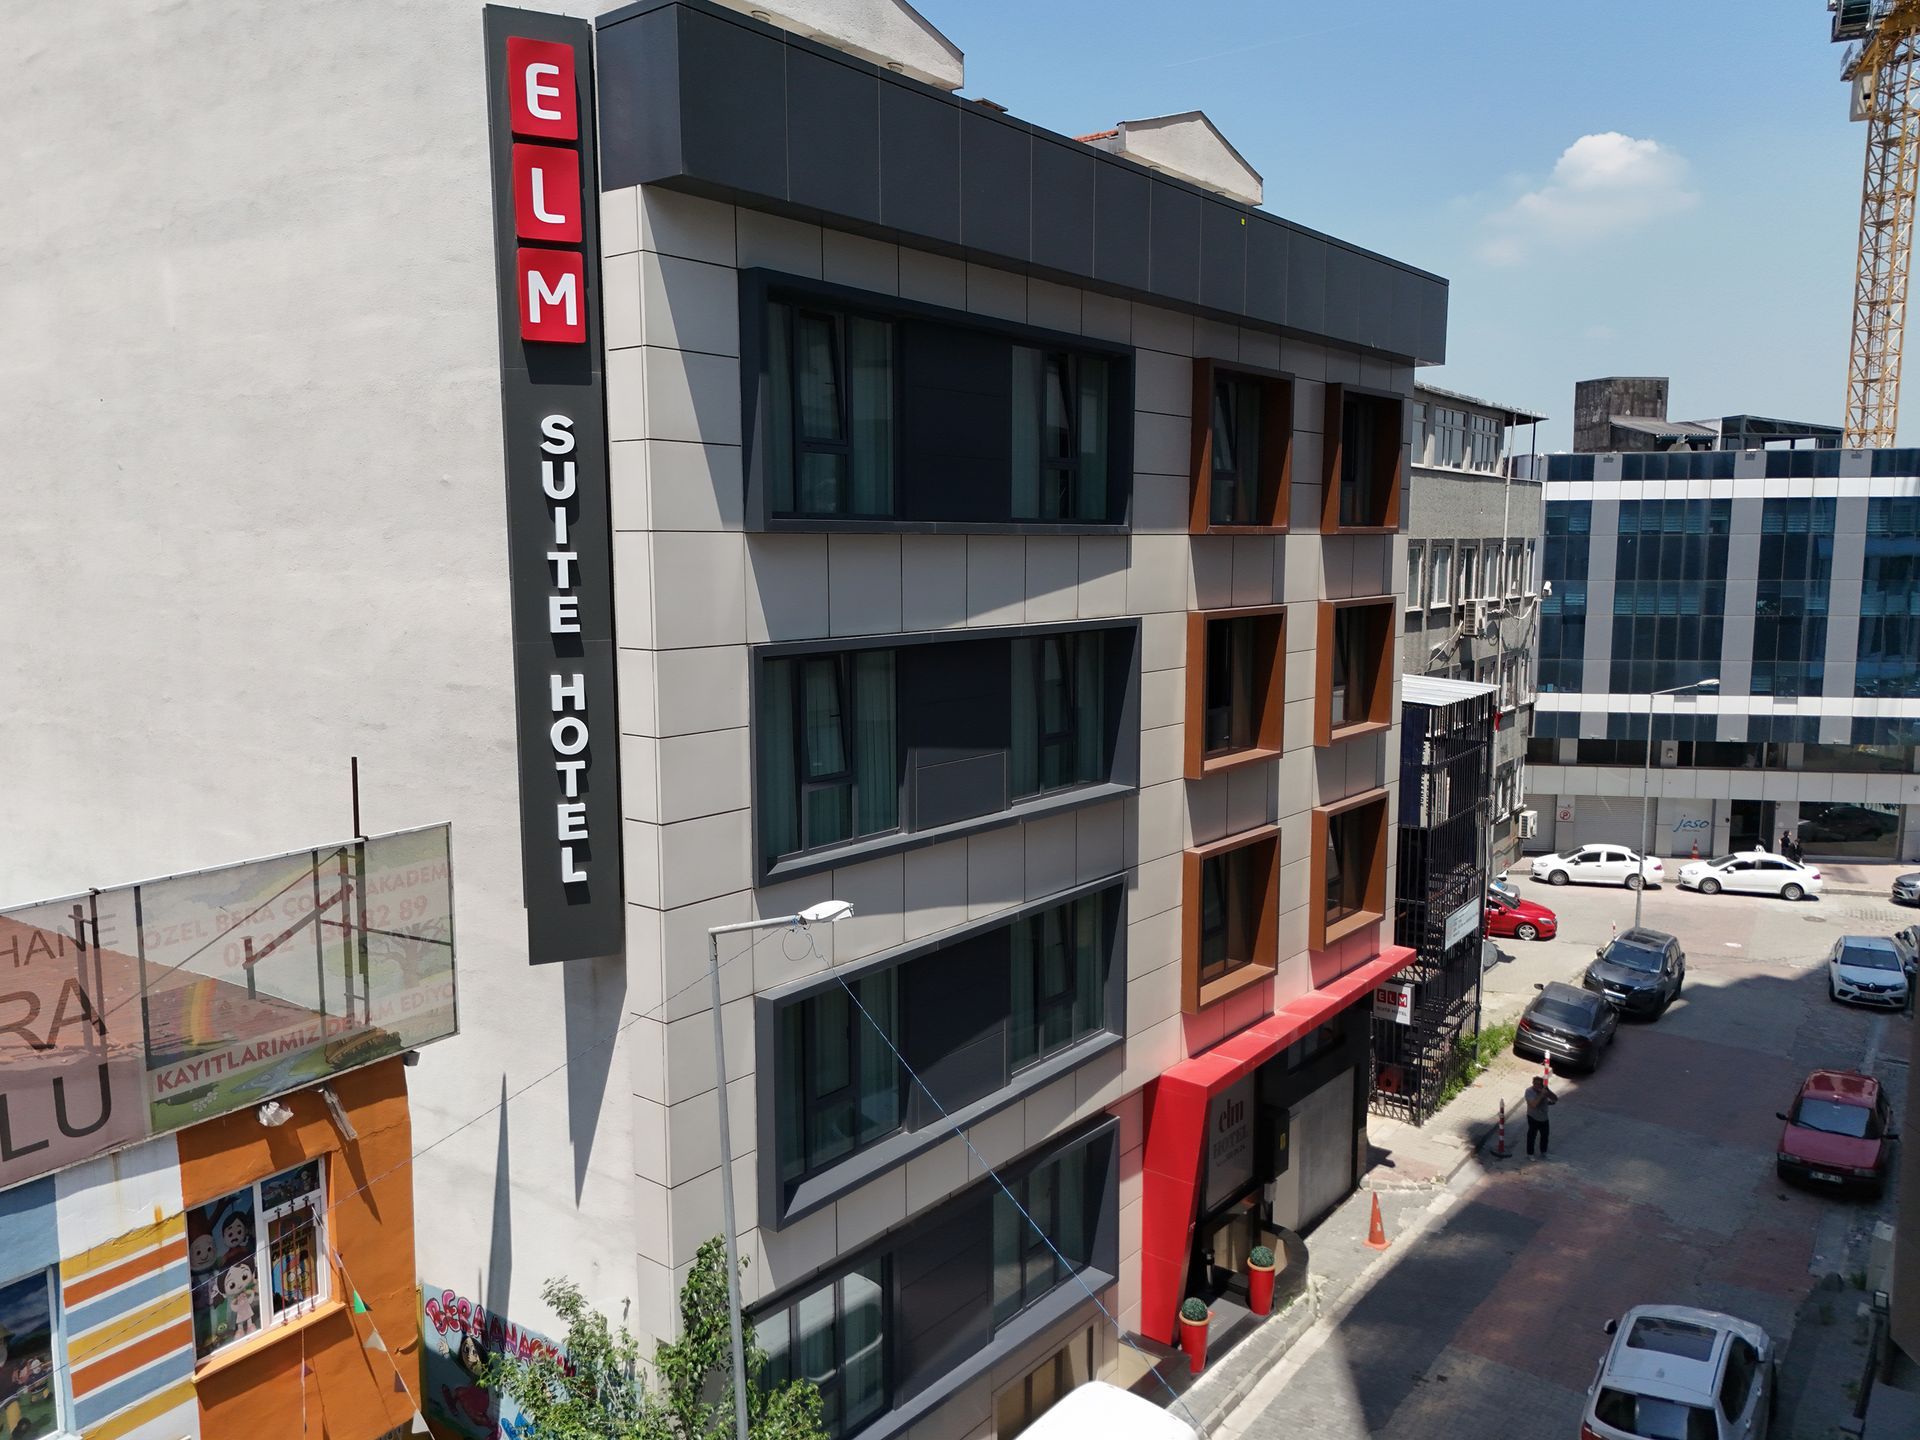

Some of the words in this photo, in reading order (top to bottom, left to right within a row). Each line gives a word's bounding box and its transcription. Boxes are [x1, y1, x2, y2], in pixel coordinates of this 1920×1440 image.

[526, 62, 577, 325] ELM
[540, 414, 580, 633] SUITE
[550, 673, 588, 883] HOTEL
[157, 1024, 320, 1093] KAYITLARIMIZ
[1378, 991, 1407, 1007] ELM
[426, 1289, 489, 1350] BERA
